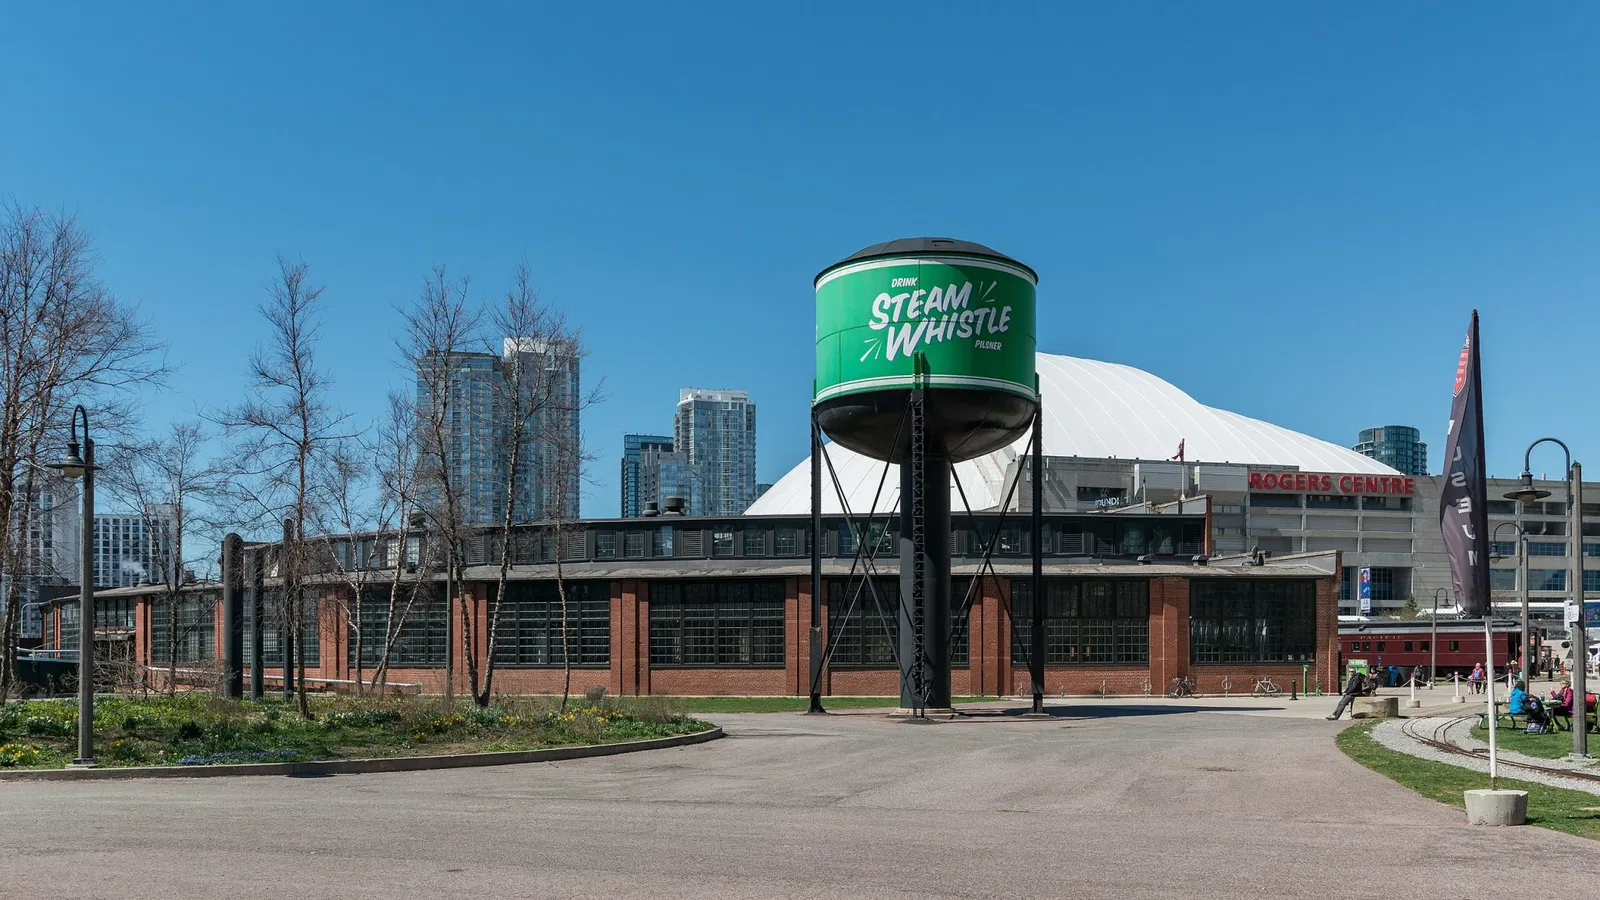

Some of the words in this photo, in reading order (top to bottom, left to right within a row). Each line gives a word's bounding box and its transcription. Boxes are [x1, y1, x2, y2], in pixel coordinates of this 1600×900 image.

[891, 277, 918, 288] DRINK
[868, 281, 973, 331] STEAM
[886, 305, 1012, 362] WHISTLE
[974, 339, 1002, 351] PILSNER
[1249, 472, 1332, 492] ROGERS
[1338, 475, 1415, 495] CENTRE
